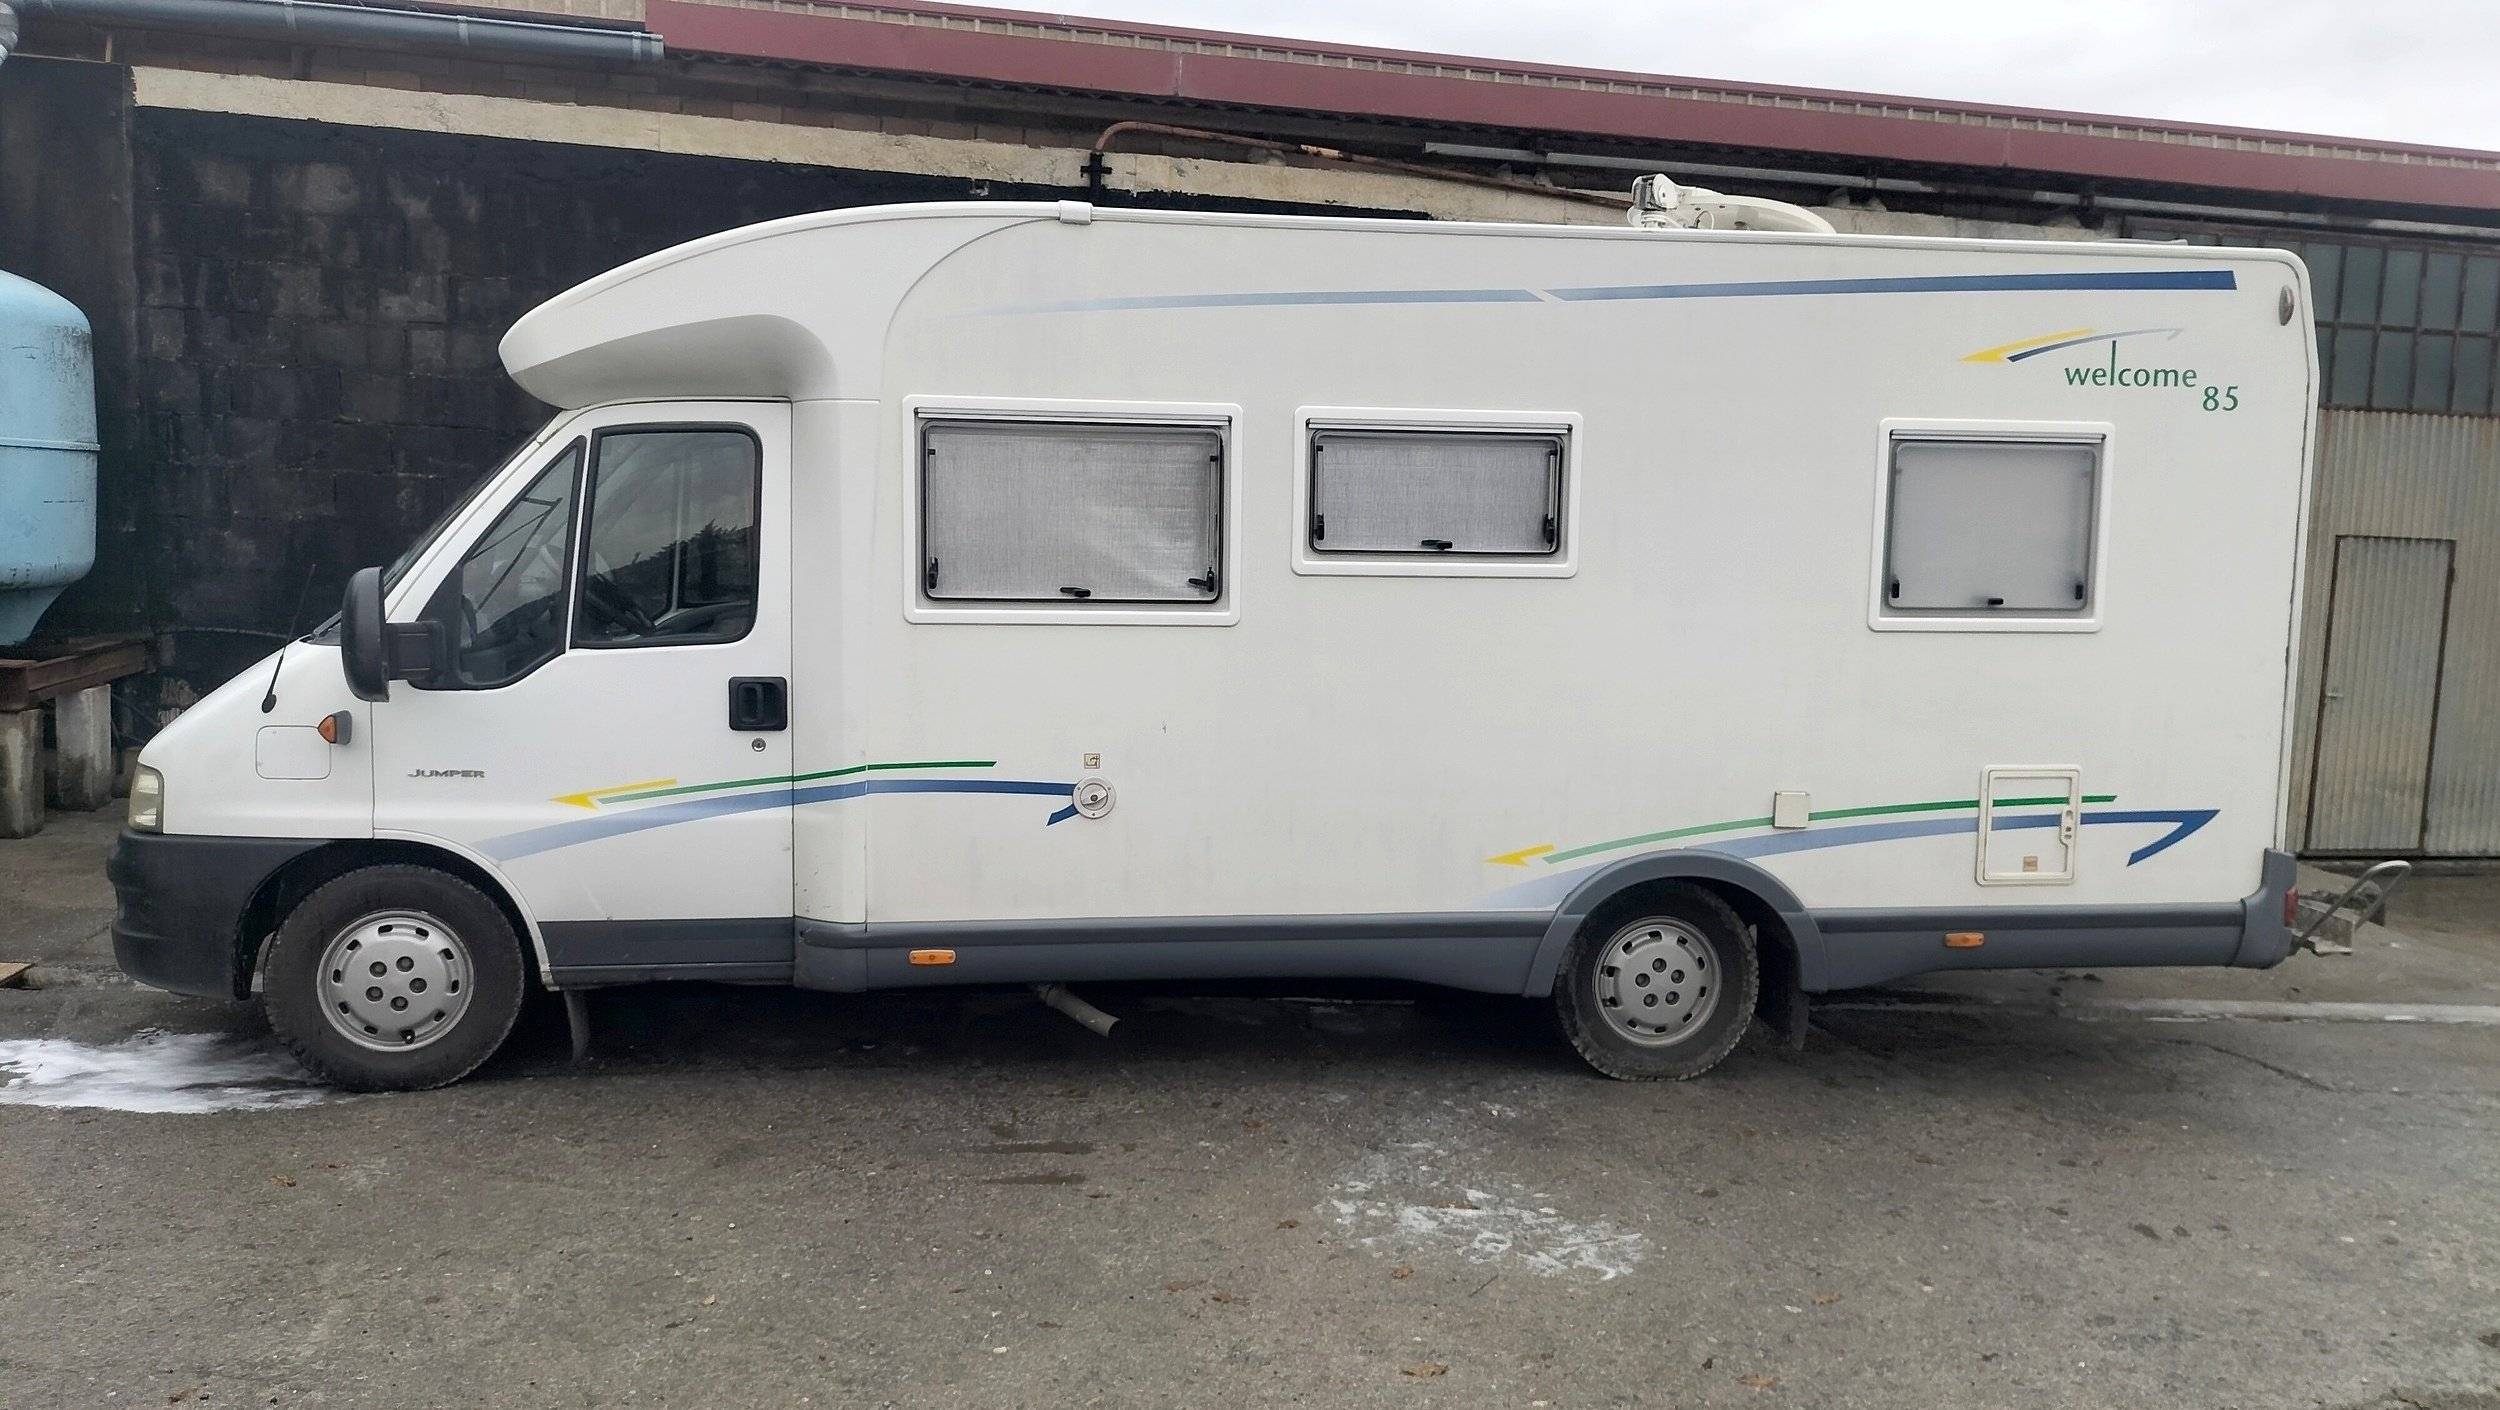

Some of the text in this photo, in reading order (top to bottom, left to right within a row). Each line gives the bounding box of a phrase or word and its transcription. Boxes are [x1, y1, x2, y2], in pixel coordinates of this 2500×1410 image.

[2064, 340, 2197, 388] welcome
[2202, 385, 2240, 411] 85
[407, 769, 485, 778] JUMPER
